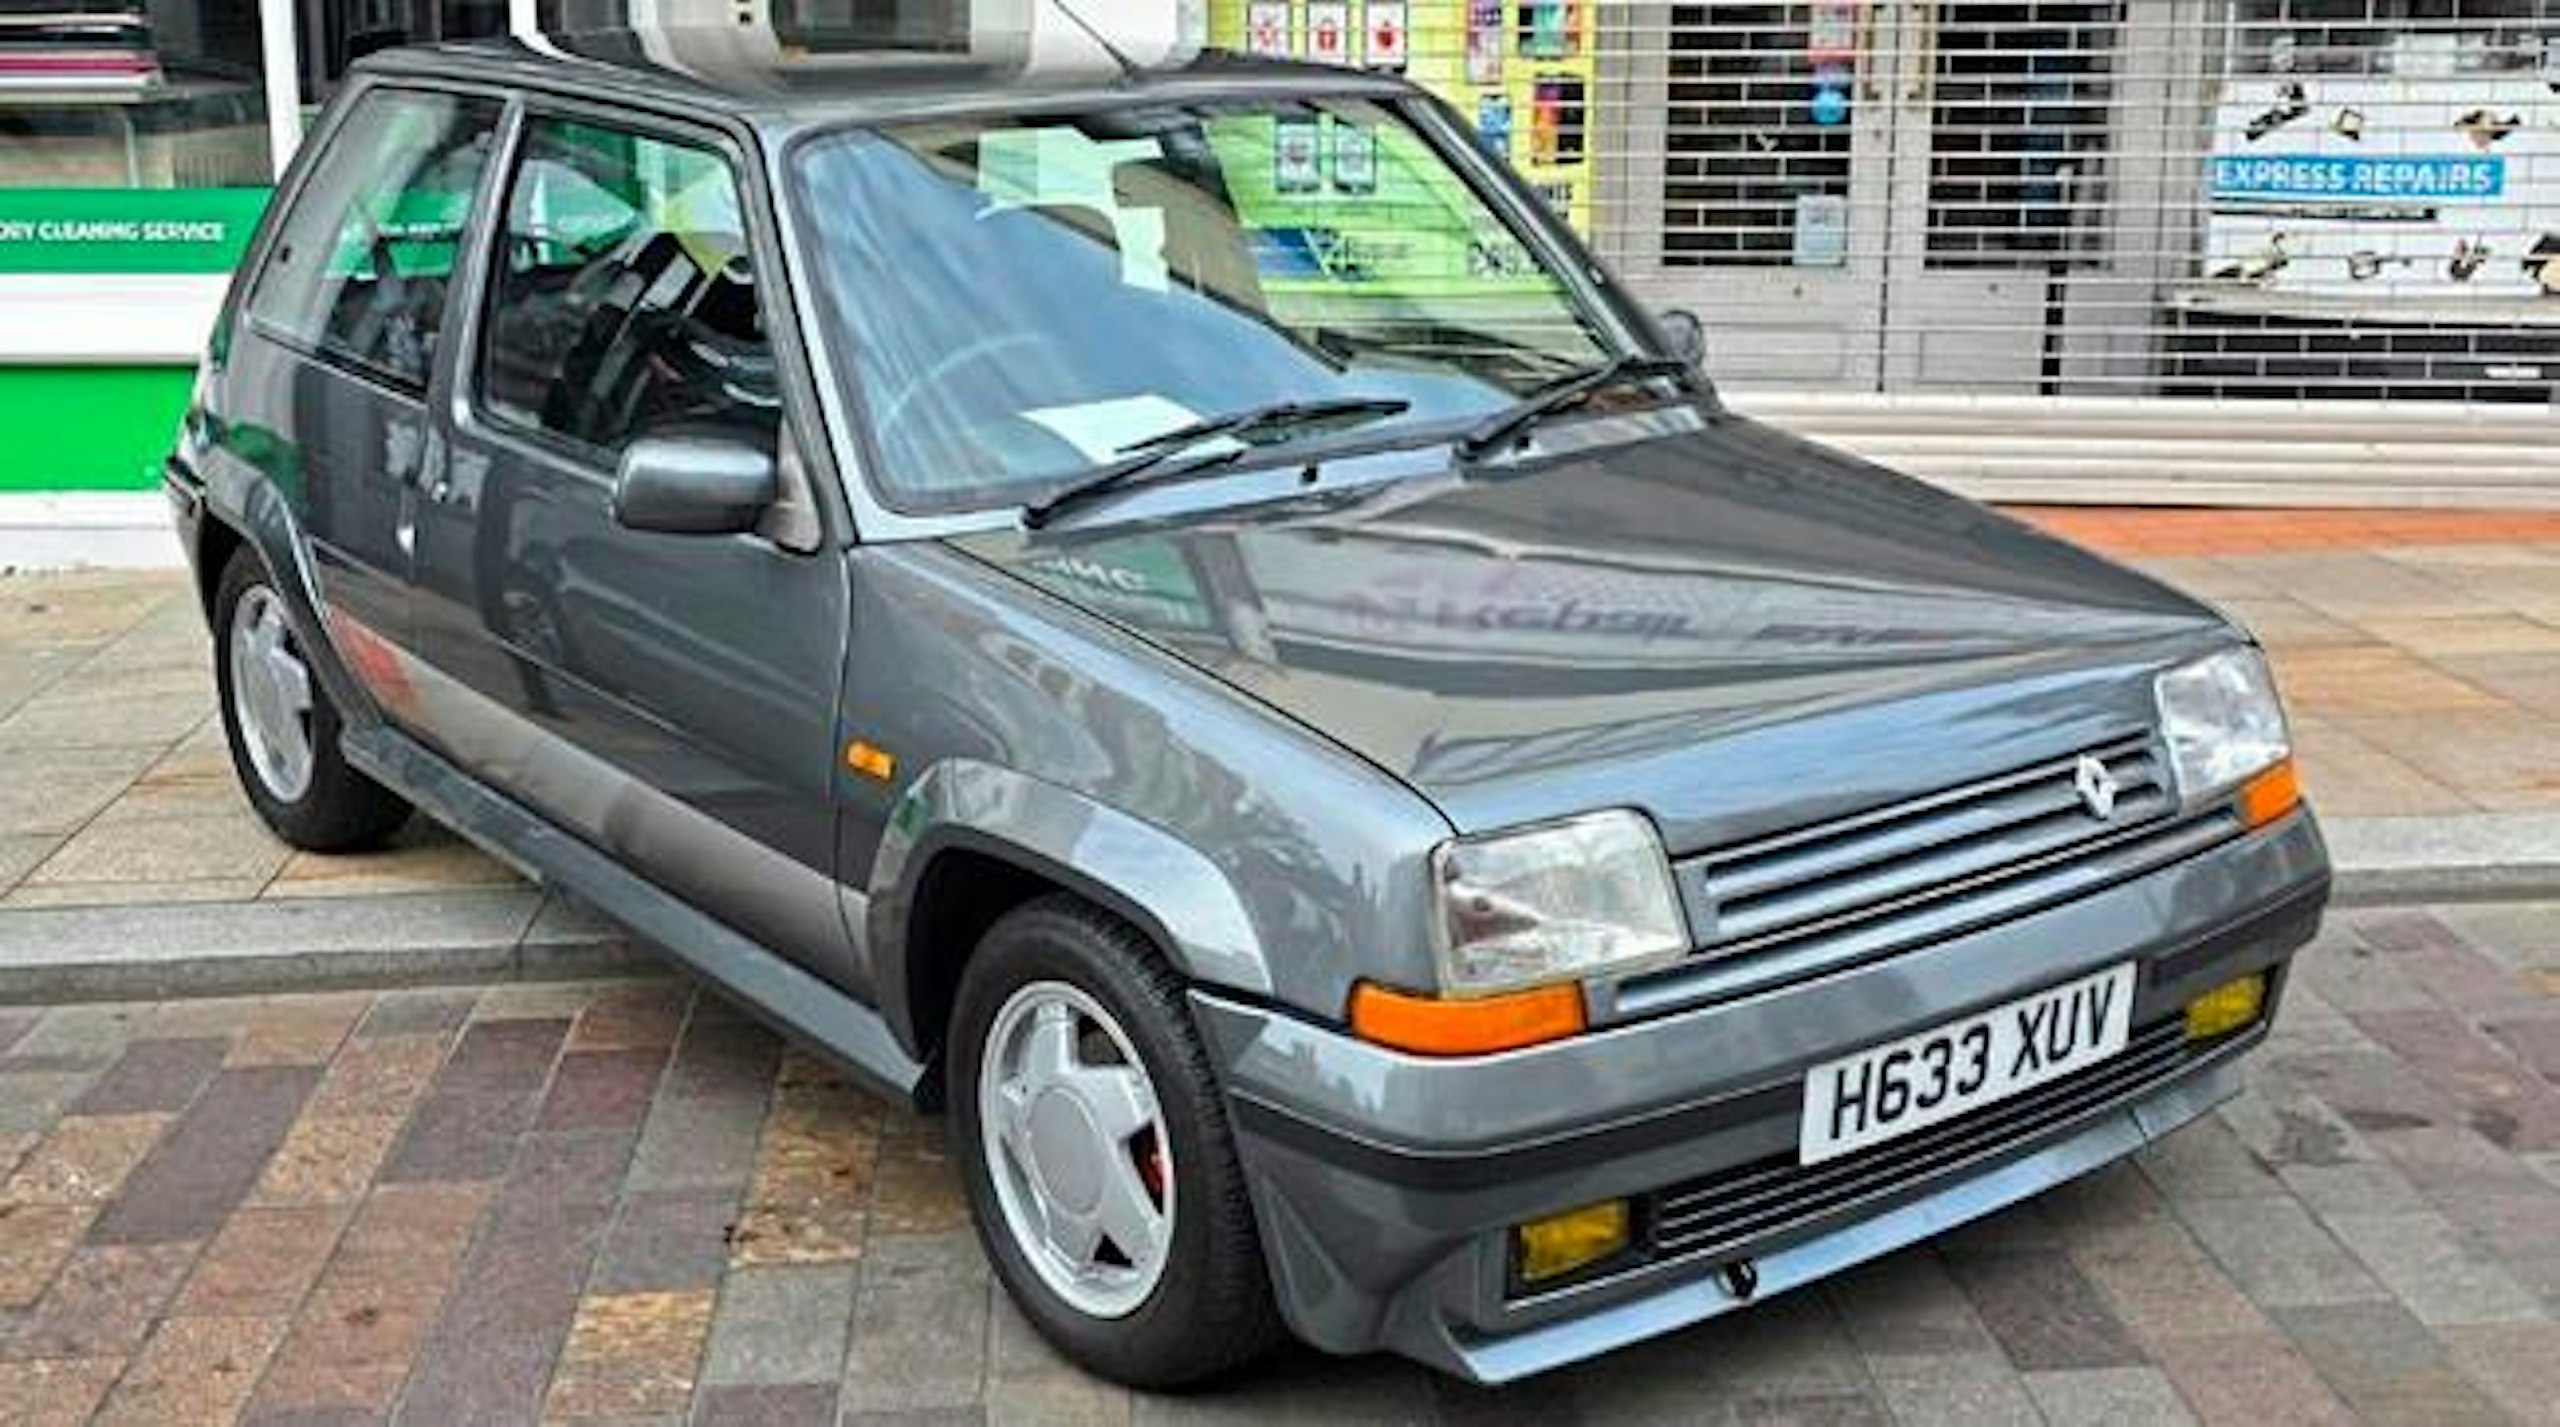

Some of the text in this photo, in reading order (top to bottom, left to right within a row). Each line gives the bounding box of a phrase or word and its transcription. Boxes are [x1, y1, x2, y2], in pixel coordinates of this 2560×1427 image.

[2215, 159, 2491, 192] EXPRESS REPAIRS
[38, 221, 139, 241] CLEANING
[143, 221, 225, 241] SERVICE
[1829, 975, 2115, 1139] H633 XUV
